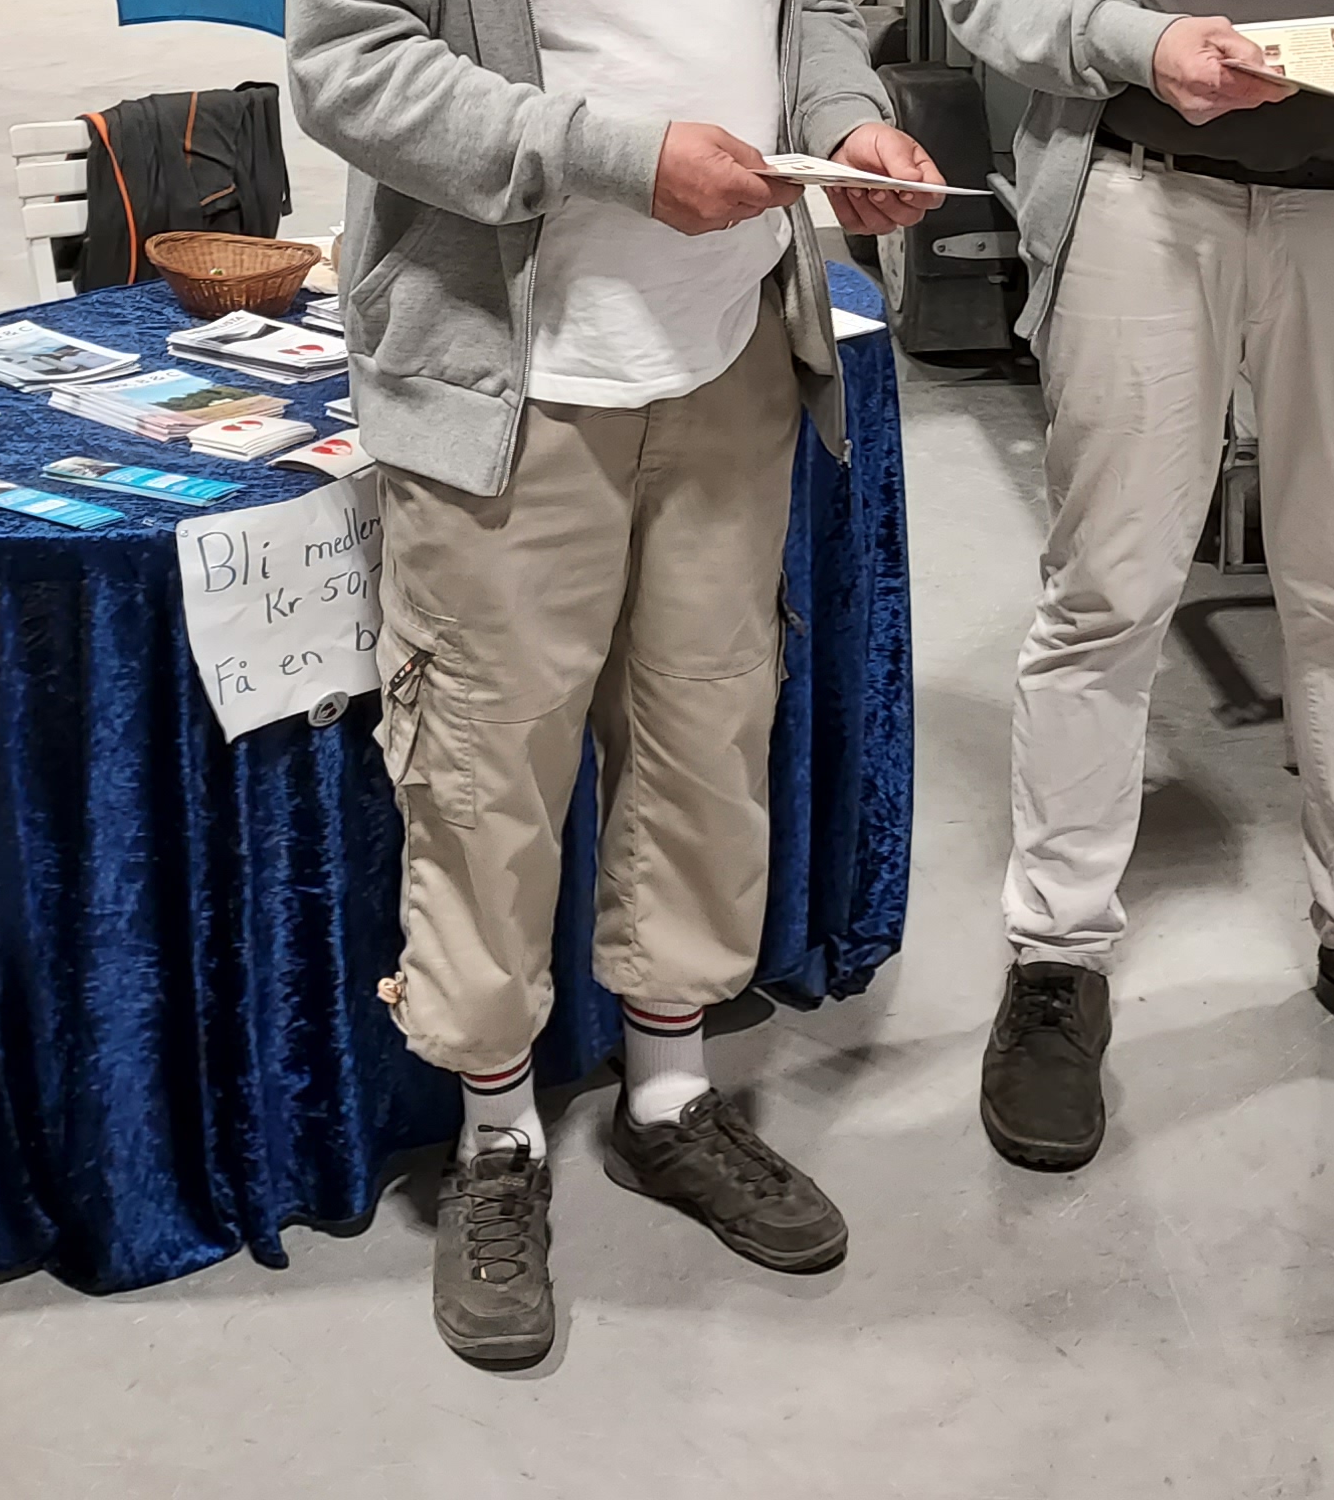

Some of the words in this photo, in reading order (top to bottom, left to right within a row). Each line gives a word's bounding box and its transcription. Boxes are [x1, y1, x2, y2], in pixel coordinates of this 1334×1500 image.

[197, 531, 271, 593] Bli
[266, 587, 303, 625] Kr
[215, 657, 257, 706] Få
[279, 650, 324, 676] en
